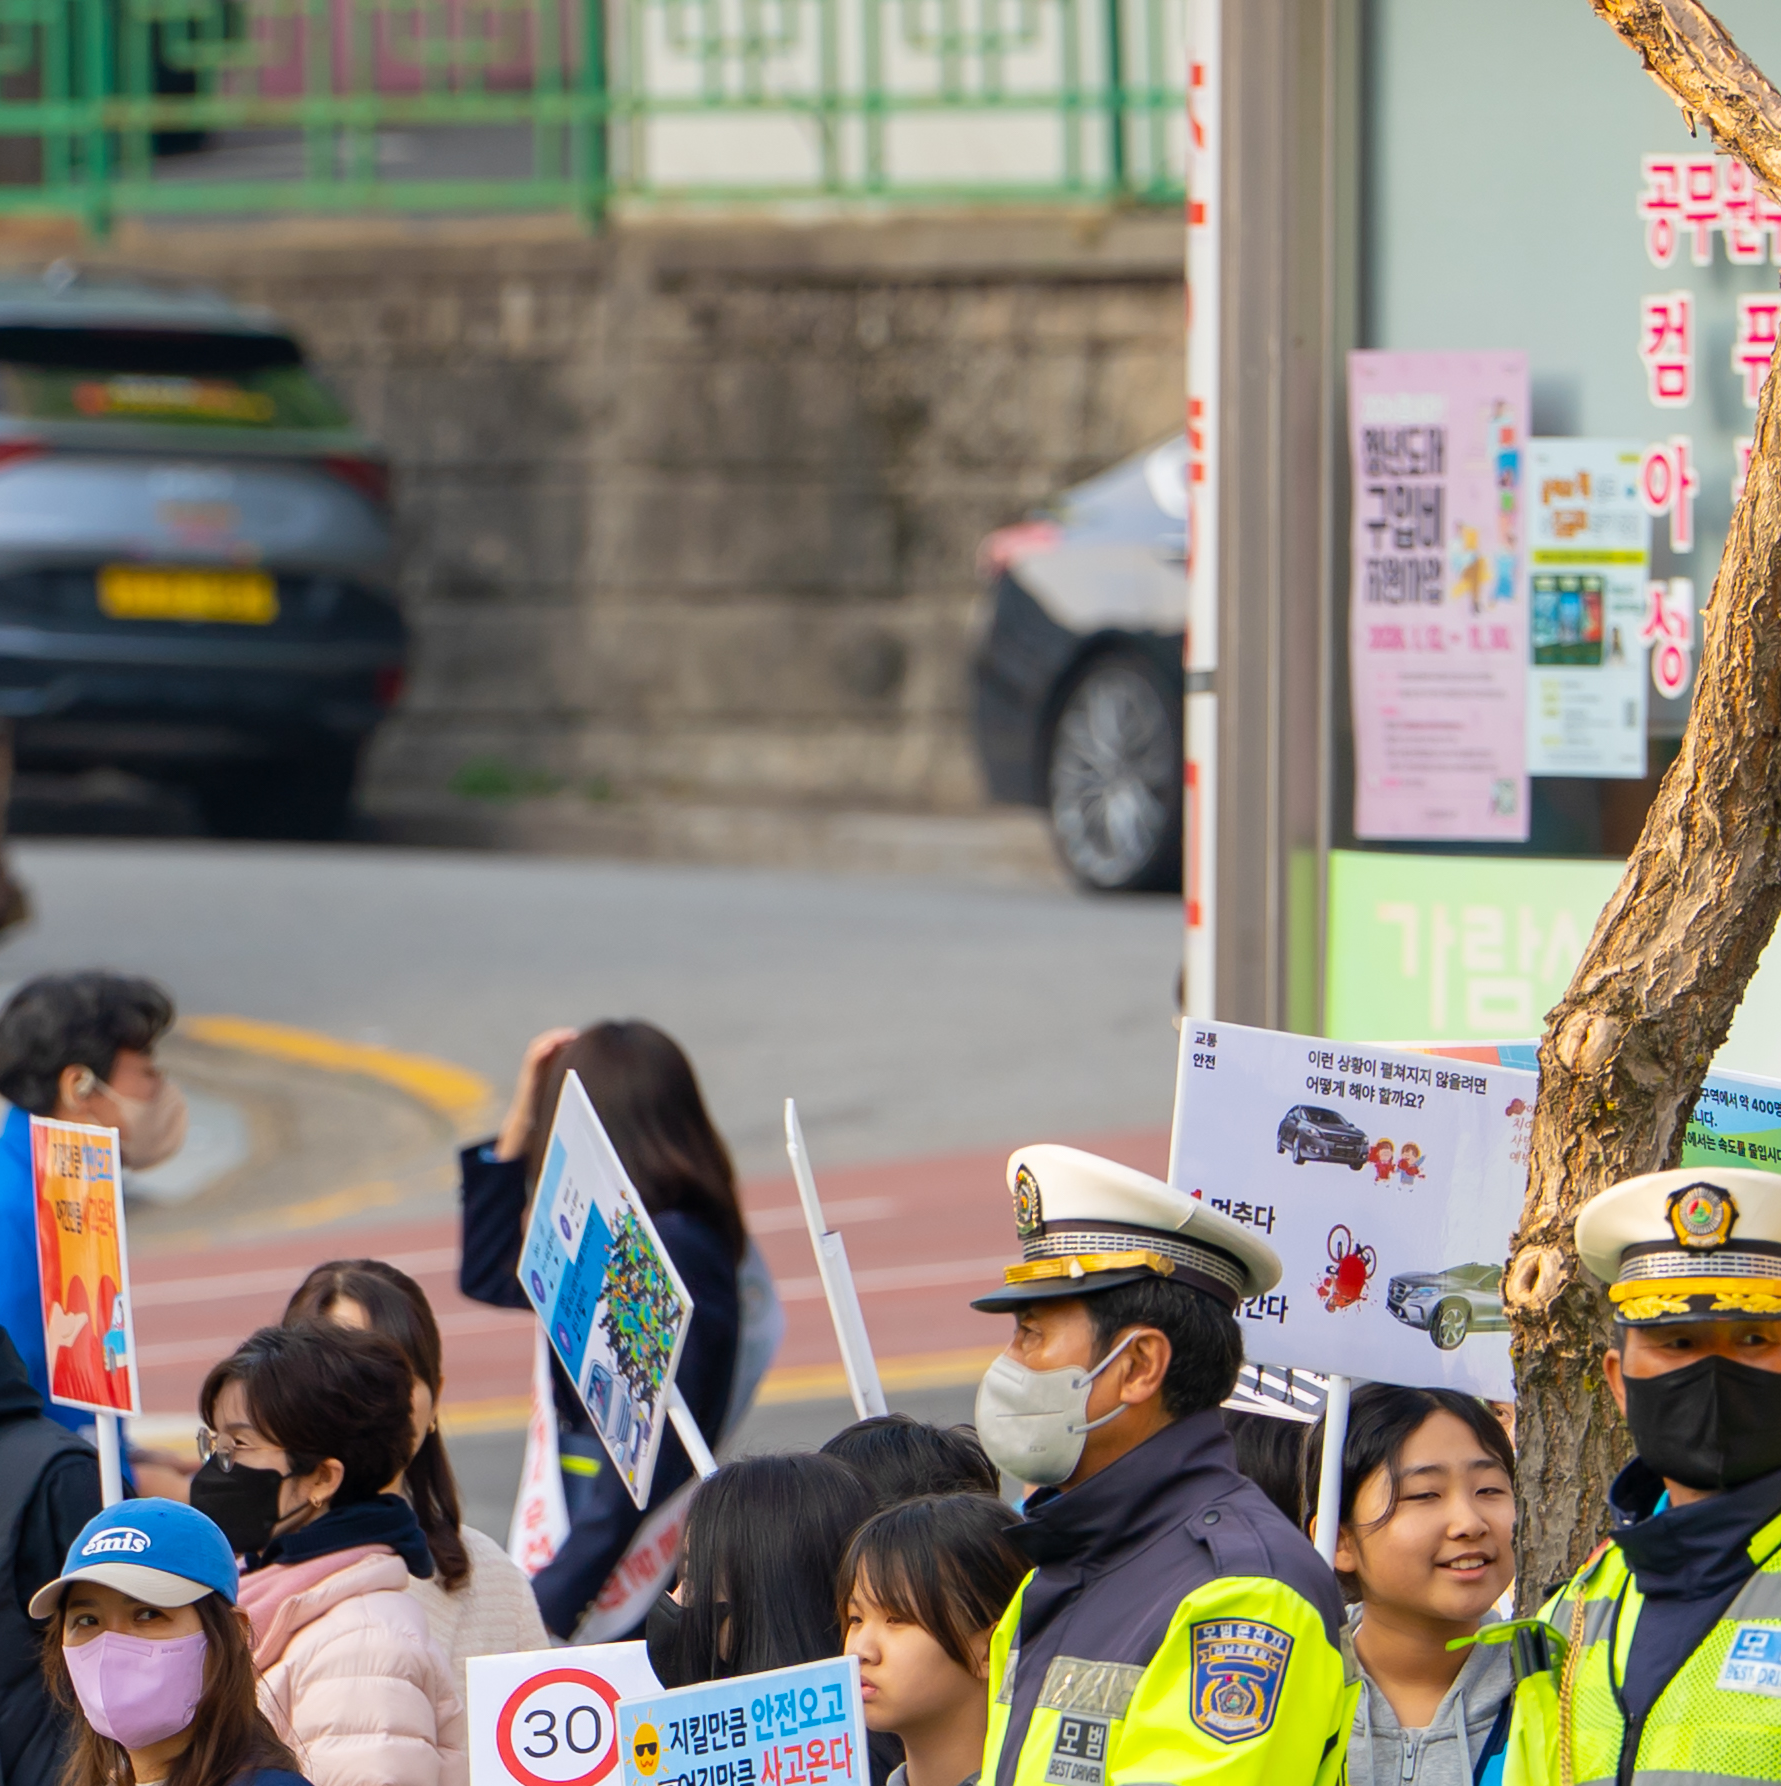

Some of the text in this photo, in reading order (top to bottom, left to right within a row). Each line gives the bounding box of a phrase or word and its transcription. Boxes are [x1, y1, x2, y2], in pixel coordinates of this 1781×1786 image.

[1194, 1030, 1218, 1048] 교통
[1192, 1052, 1216, 1071] 안전
[1307, 1049, 1487, 1096] 이런 상황이 펼쳐지지 않을려면
[1305, 1074, 1425, 1110] 어떻게 해야 할까요?
[1739, 1094, 1750, 1112] 약
[1717, 1135, 1747, 1159] 속도를
[81, 1530, 150, 1557] emis
[1202, 1623, 1285, 1649] 모범운전자
[1724, 1664, 1755, 1681] BEST
[522, 1704, 602, 1760] 30
[668, 1681, 847, 1757] 지킬만큼 안전오고
[1058, 1713, 1104, 1762] 모범
